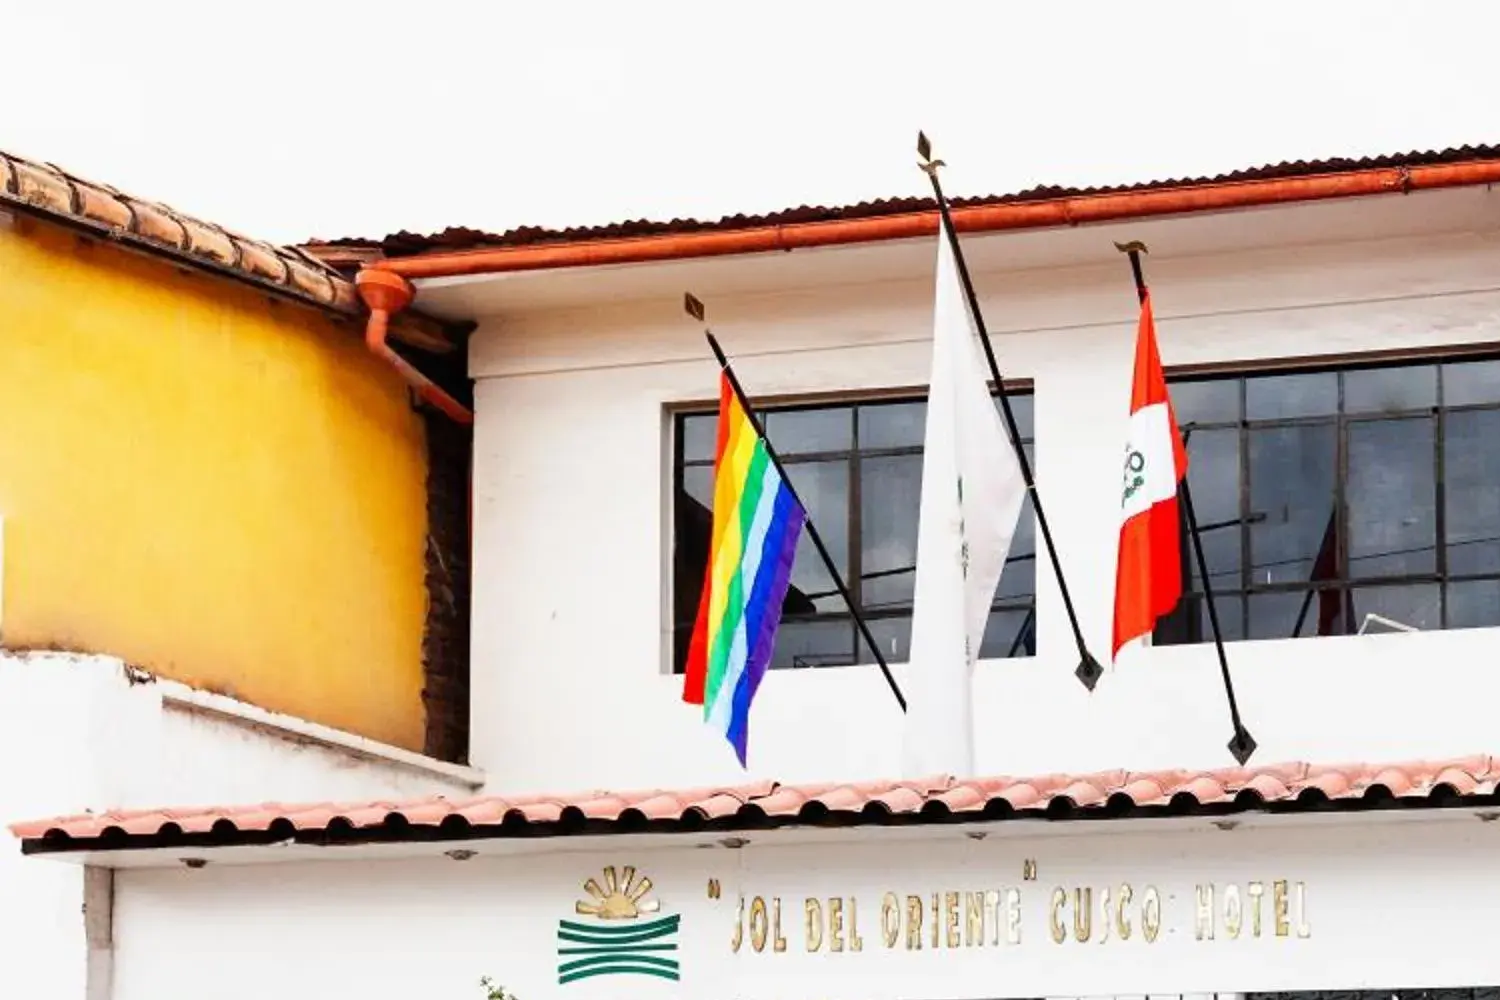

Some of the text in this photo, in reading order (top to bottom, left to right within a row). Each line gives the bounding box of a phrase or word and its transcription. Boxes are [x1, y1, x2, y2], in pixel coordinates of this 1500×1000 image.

[804, 896, 863, 952] DEL
[1049, 882, 1162, 944] CUSCO
[1195, 879, 1311, 941] HOTEL
